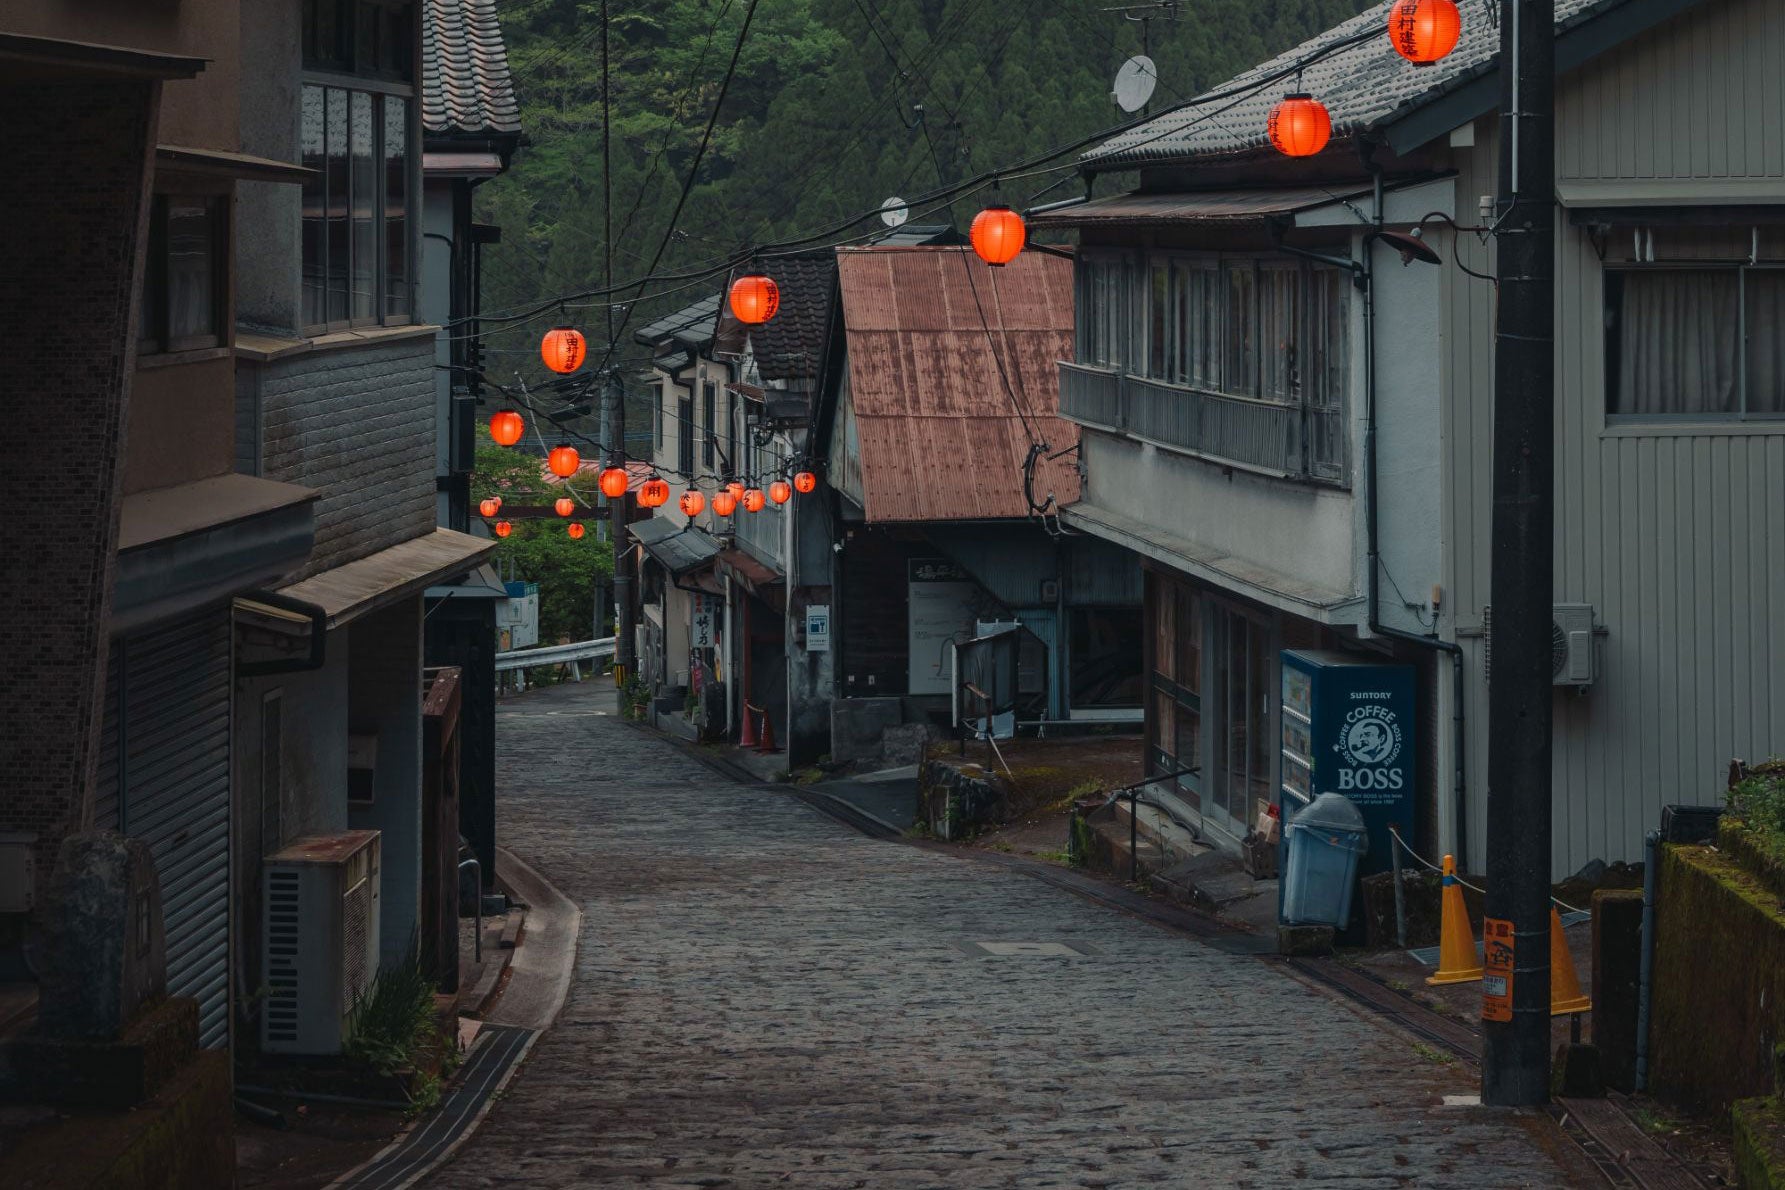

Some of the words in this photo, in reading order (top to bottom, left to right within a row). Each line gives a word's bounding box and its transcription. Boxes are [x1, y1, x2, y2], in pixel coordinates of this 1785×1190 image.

[1397, 0, 1418, 56] 田村建築
[1346, 705, 1396, 723] COFFEE
[1338, 768, 1403, 790] BOSS
